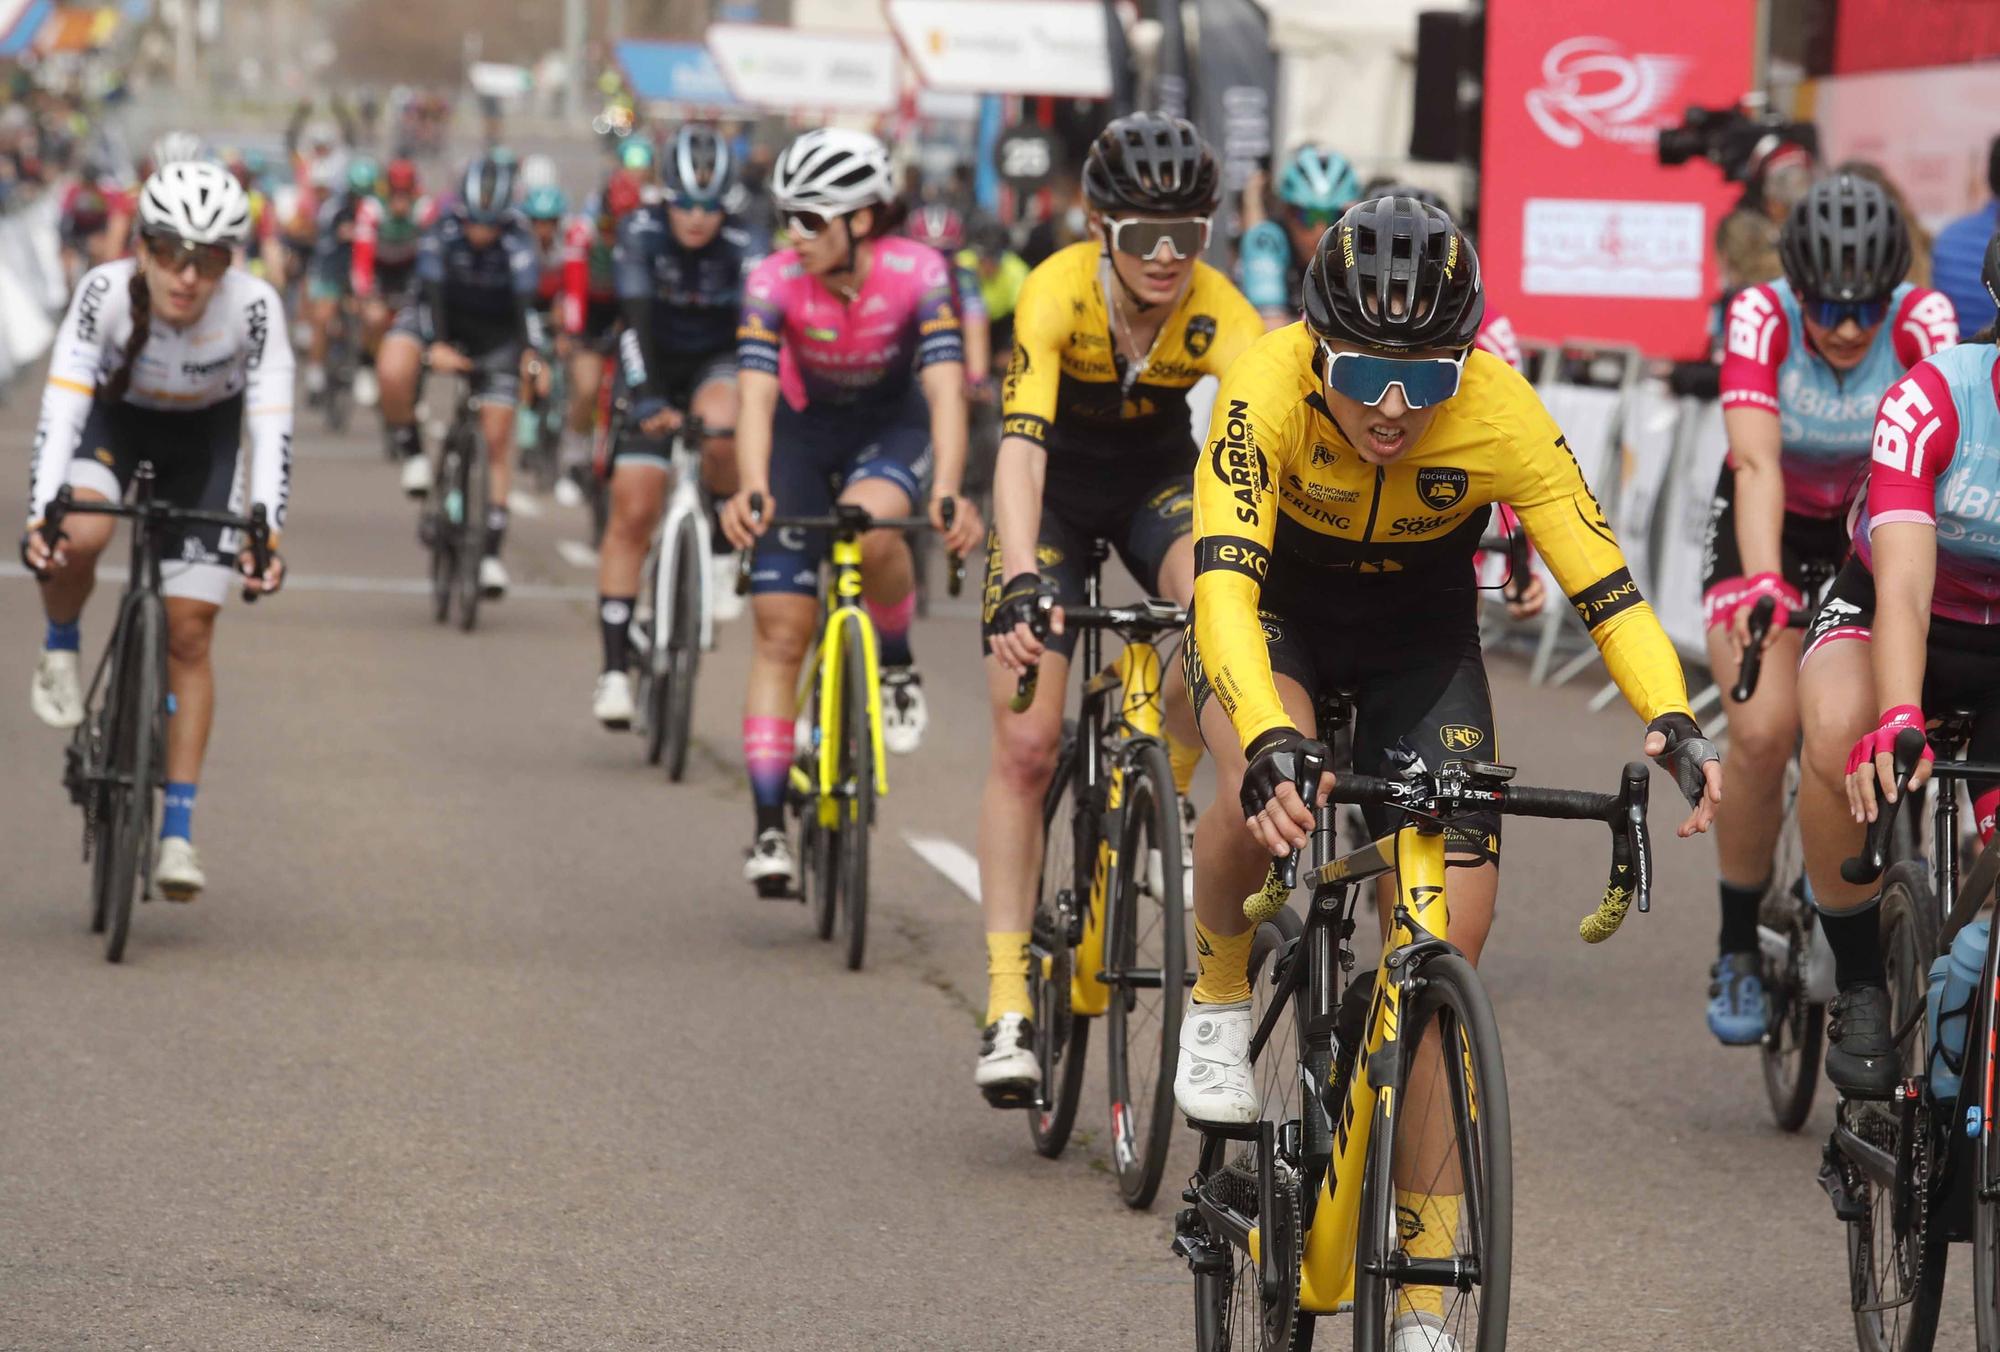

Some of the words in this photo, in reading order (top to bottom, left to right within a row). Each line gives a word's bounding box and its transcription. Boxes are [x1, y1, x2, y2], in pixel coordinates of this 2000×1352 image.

[1729, 287, 1774, 361] BH
[1872, 378, 1934, 473] BH
[1227, 399, 1259, 528] SARRION
[1419, 473, 1467, 482] ROCHELAIS
[1305, 488, 1358, 504] CONTINENTAL
[1308, 482, 1324, 492] UCI
[1324, 486, 1360, 499] WOMEN'S
[1483, 766, 1510, 775] GARMIN
[1635, 824, 1647, 891] ULTEGRA
[1321, 859, 1352, 884] TIME
